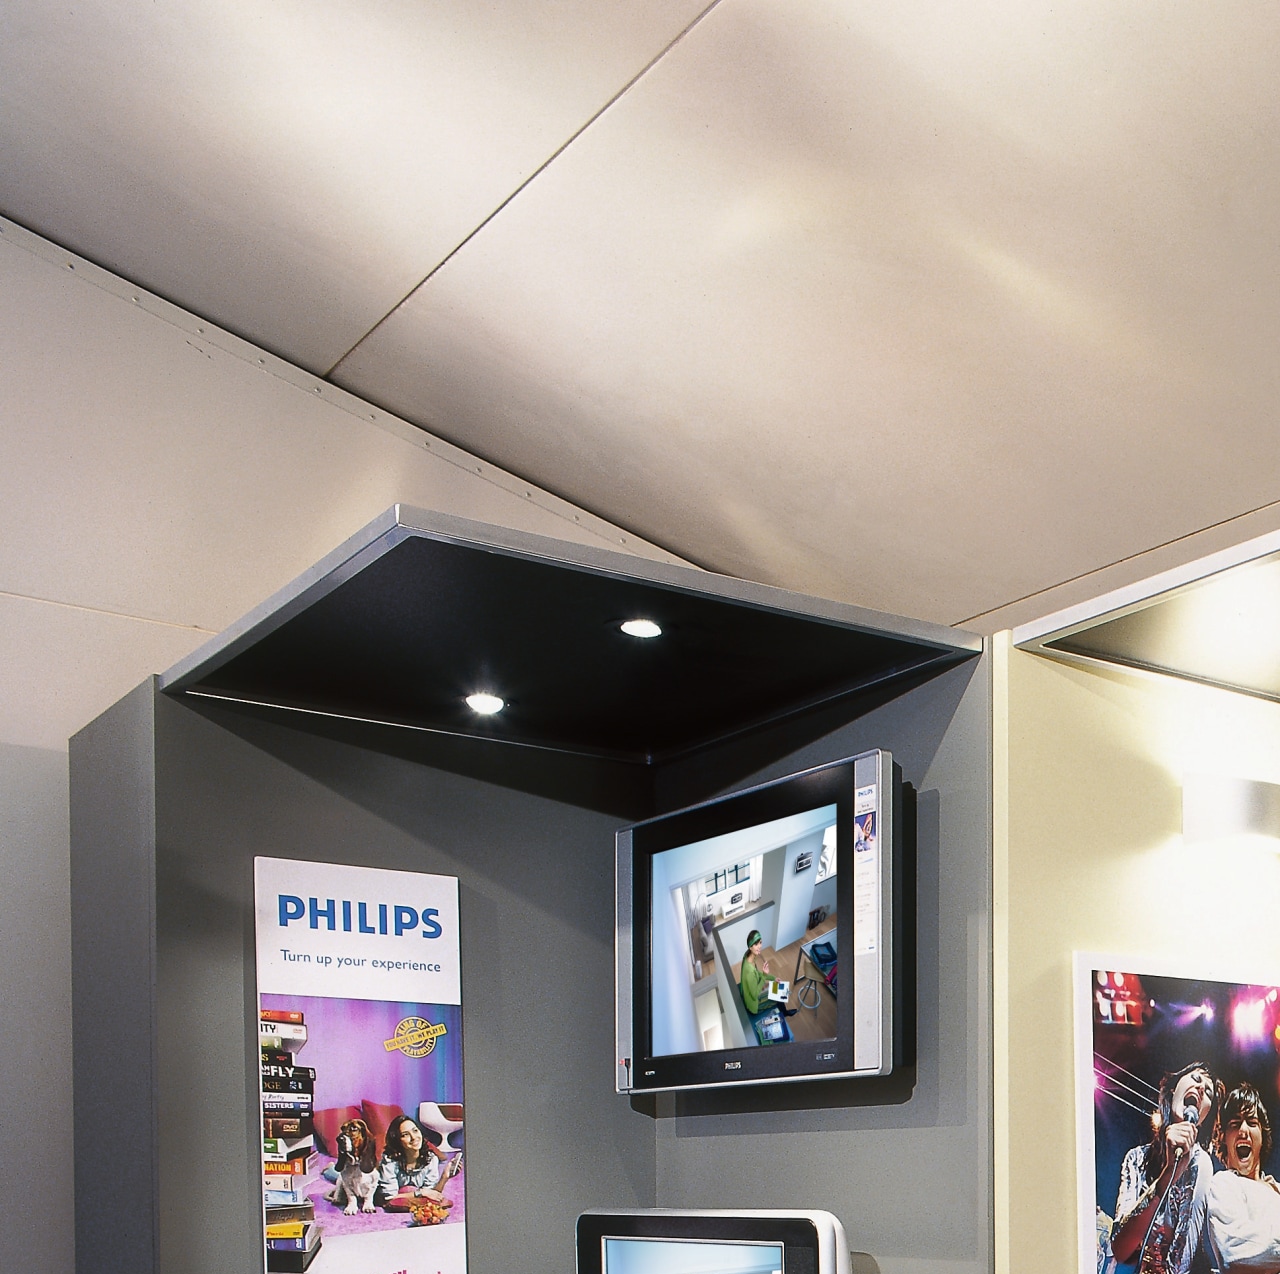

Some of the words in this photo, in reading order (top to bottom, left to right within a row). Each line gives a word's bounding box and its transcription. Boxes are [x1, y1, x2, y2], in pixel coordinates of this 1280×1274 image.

[278, 894, 443, 939] PHILIPS
[280, 949, 311, 963] Turn
[316, 954, 332, 967] up
[337, 956, 367, 968] your
[371, 957, 441, 972] experience
[270, 1066, 295, 1078] FLY
